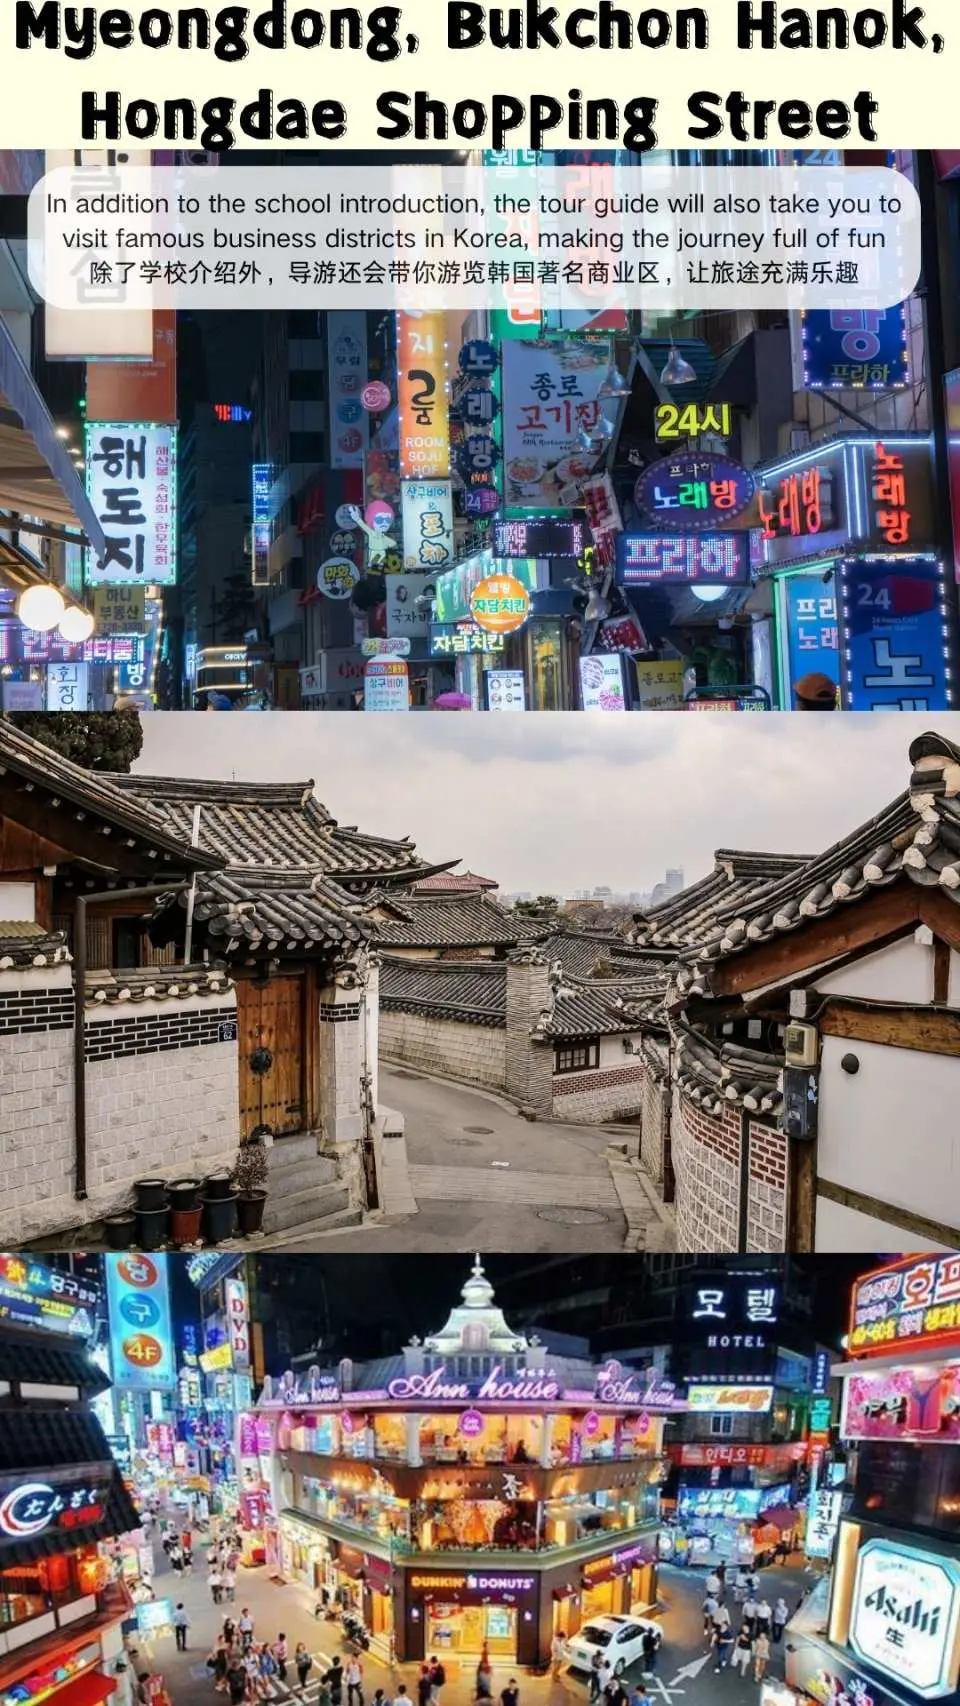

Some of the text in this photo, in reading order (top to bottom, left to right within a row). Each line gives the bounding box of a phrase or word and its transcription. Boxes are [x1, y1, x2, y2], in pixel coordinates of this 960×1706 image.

[831, 364, 890, 383] 프라하
[530, 372, 584, 401] 종로
[656, 403, 732, 438] 24시
[405, 436, 445, 448] ROOM
[408, 451, 442, 462] SOJU
[412, 466, 439, 476] HOF
[653, 480, 740, 511] 노래방
[758, 465, 826, 542] 노래방
[871, 440, 912, 545] 노래방
[624, 538, 740, 579] 프라하
[473, 598, 527, 614] 자담치킨
[856, 583, 892, 610] 24
[100, 606, 140, 622] 부동산
[433, 633, 504, 652] 자담치킨
[223, 1031, 233, 1040] 62
[692, 1288, 777, 1322] 모텔
[231, 1299, 247, 1351] DVD
[127, 1341, 157, 1361] 4F
[707, 1335, 765, 1347] HOTEL
[388, 1365, 559, 1400] Ann house
[411, 1575, 465, 1588] DUNKIN'
[864, 1585, 942, 1636] Asahi
